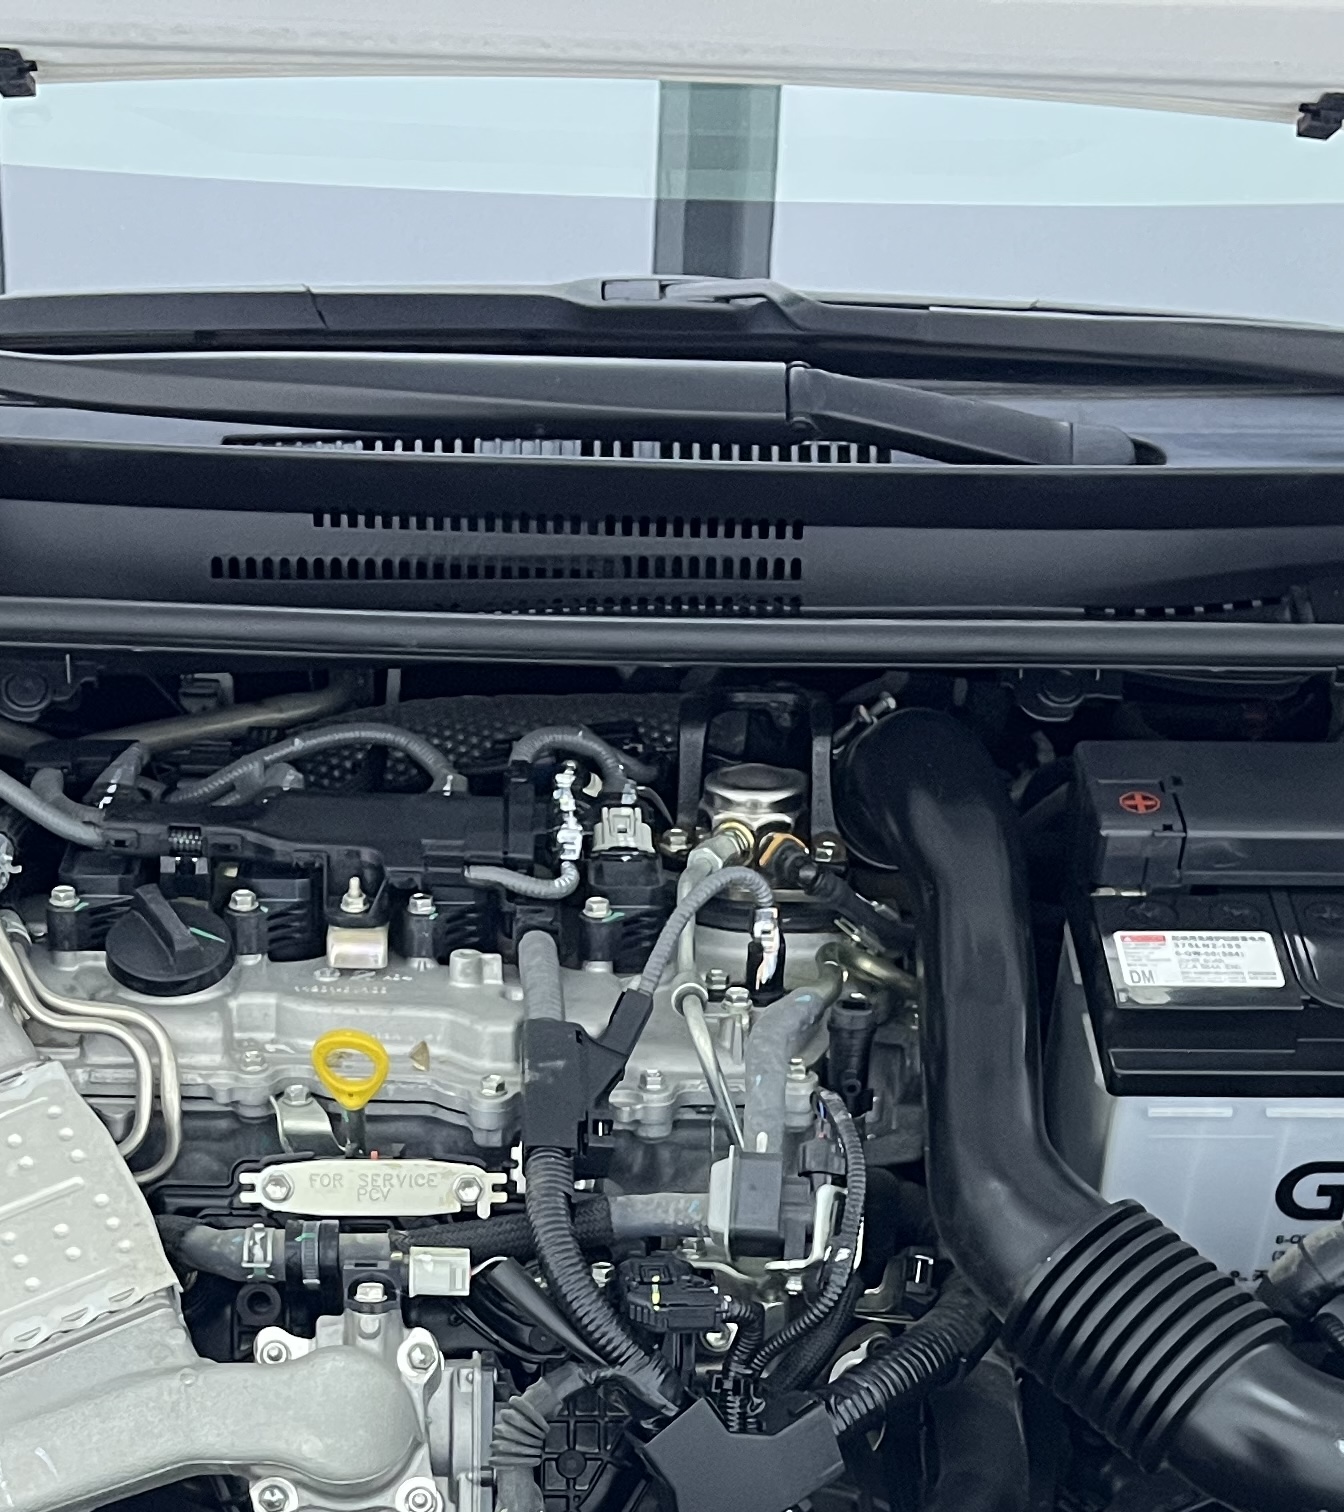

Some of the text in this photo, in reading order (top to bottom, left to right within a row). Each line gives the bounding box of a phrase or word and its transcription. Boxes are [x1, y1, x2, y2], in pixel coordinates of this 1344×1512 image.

[1129, 969, 1156, 985] DM
[308, 1172, 439, 1188] FOR SERVICE
[356, 1187, 391, 1202] PCV
